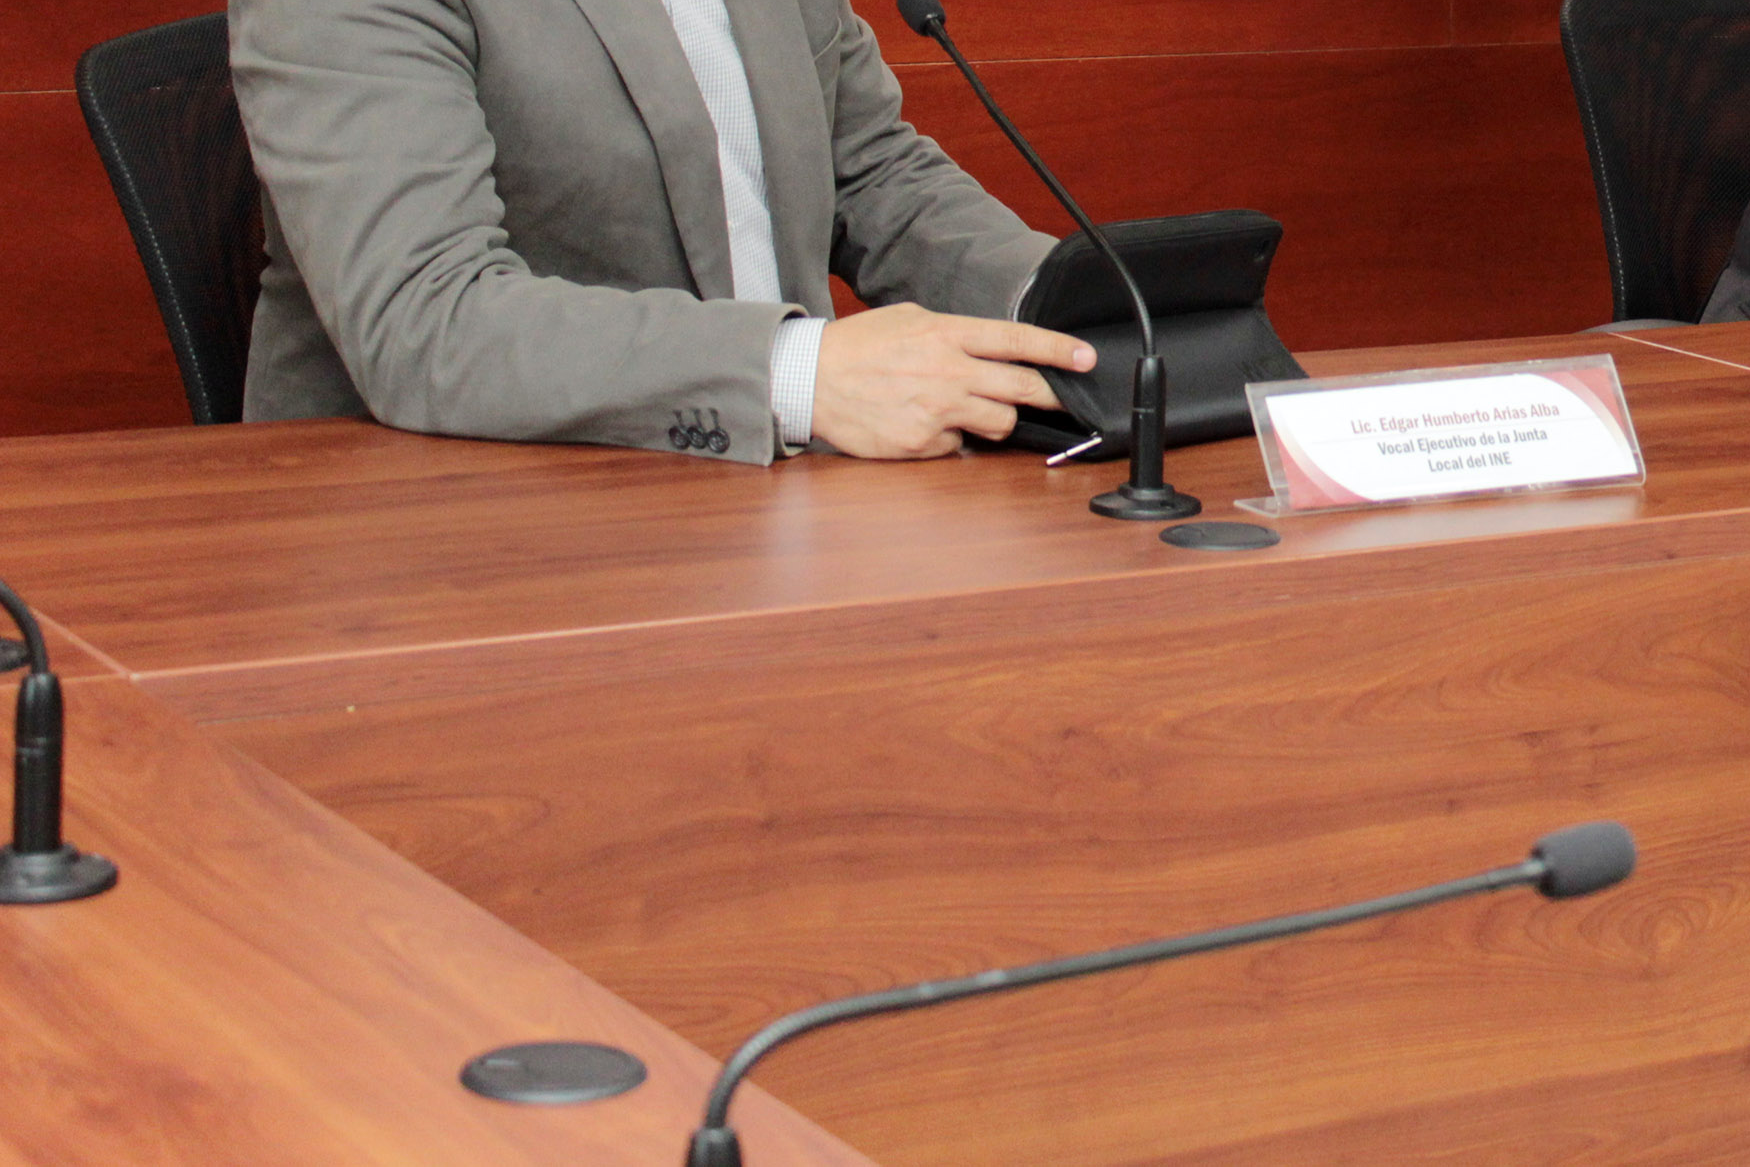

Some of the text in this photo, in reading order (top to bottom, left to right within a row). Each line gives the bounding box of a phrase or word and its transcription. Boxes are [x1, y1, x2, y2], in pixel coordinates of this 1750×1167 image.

[1351, 403, 1561, 435] Lic. Edgar Humberto Arias Alba
[1377, 427, 1548, 456] Vocal Ejecutivo de la Junta
[1427, 451, 1513, 473] Local del INE
